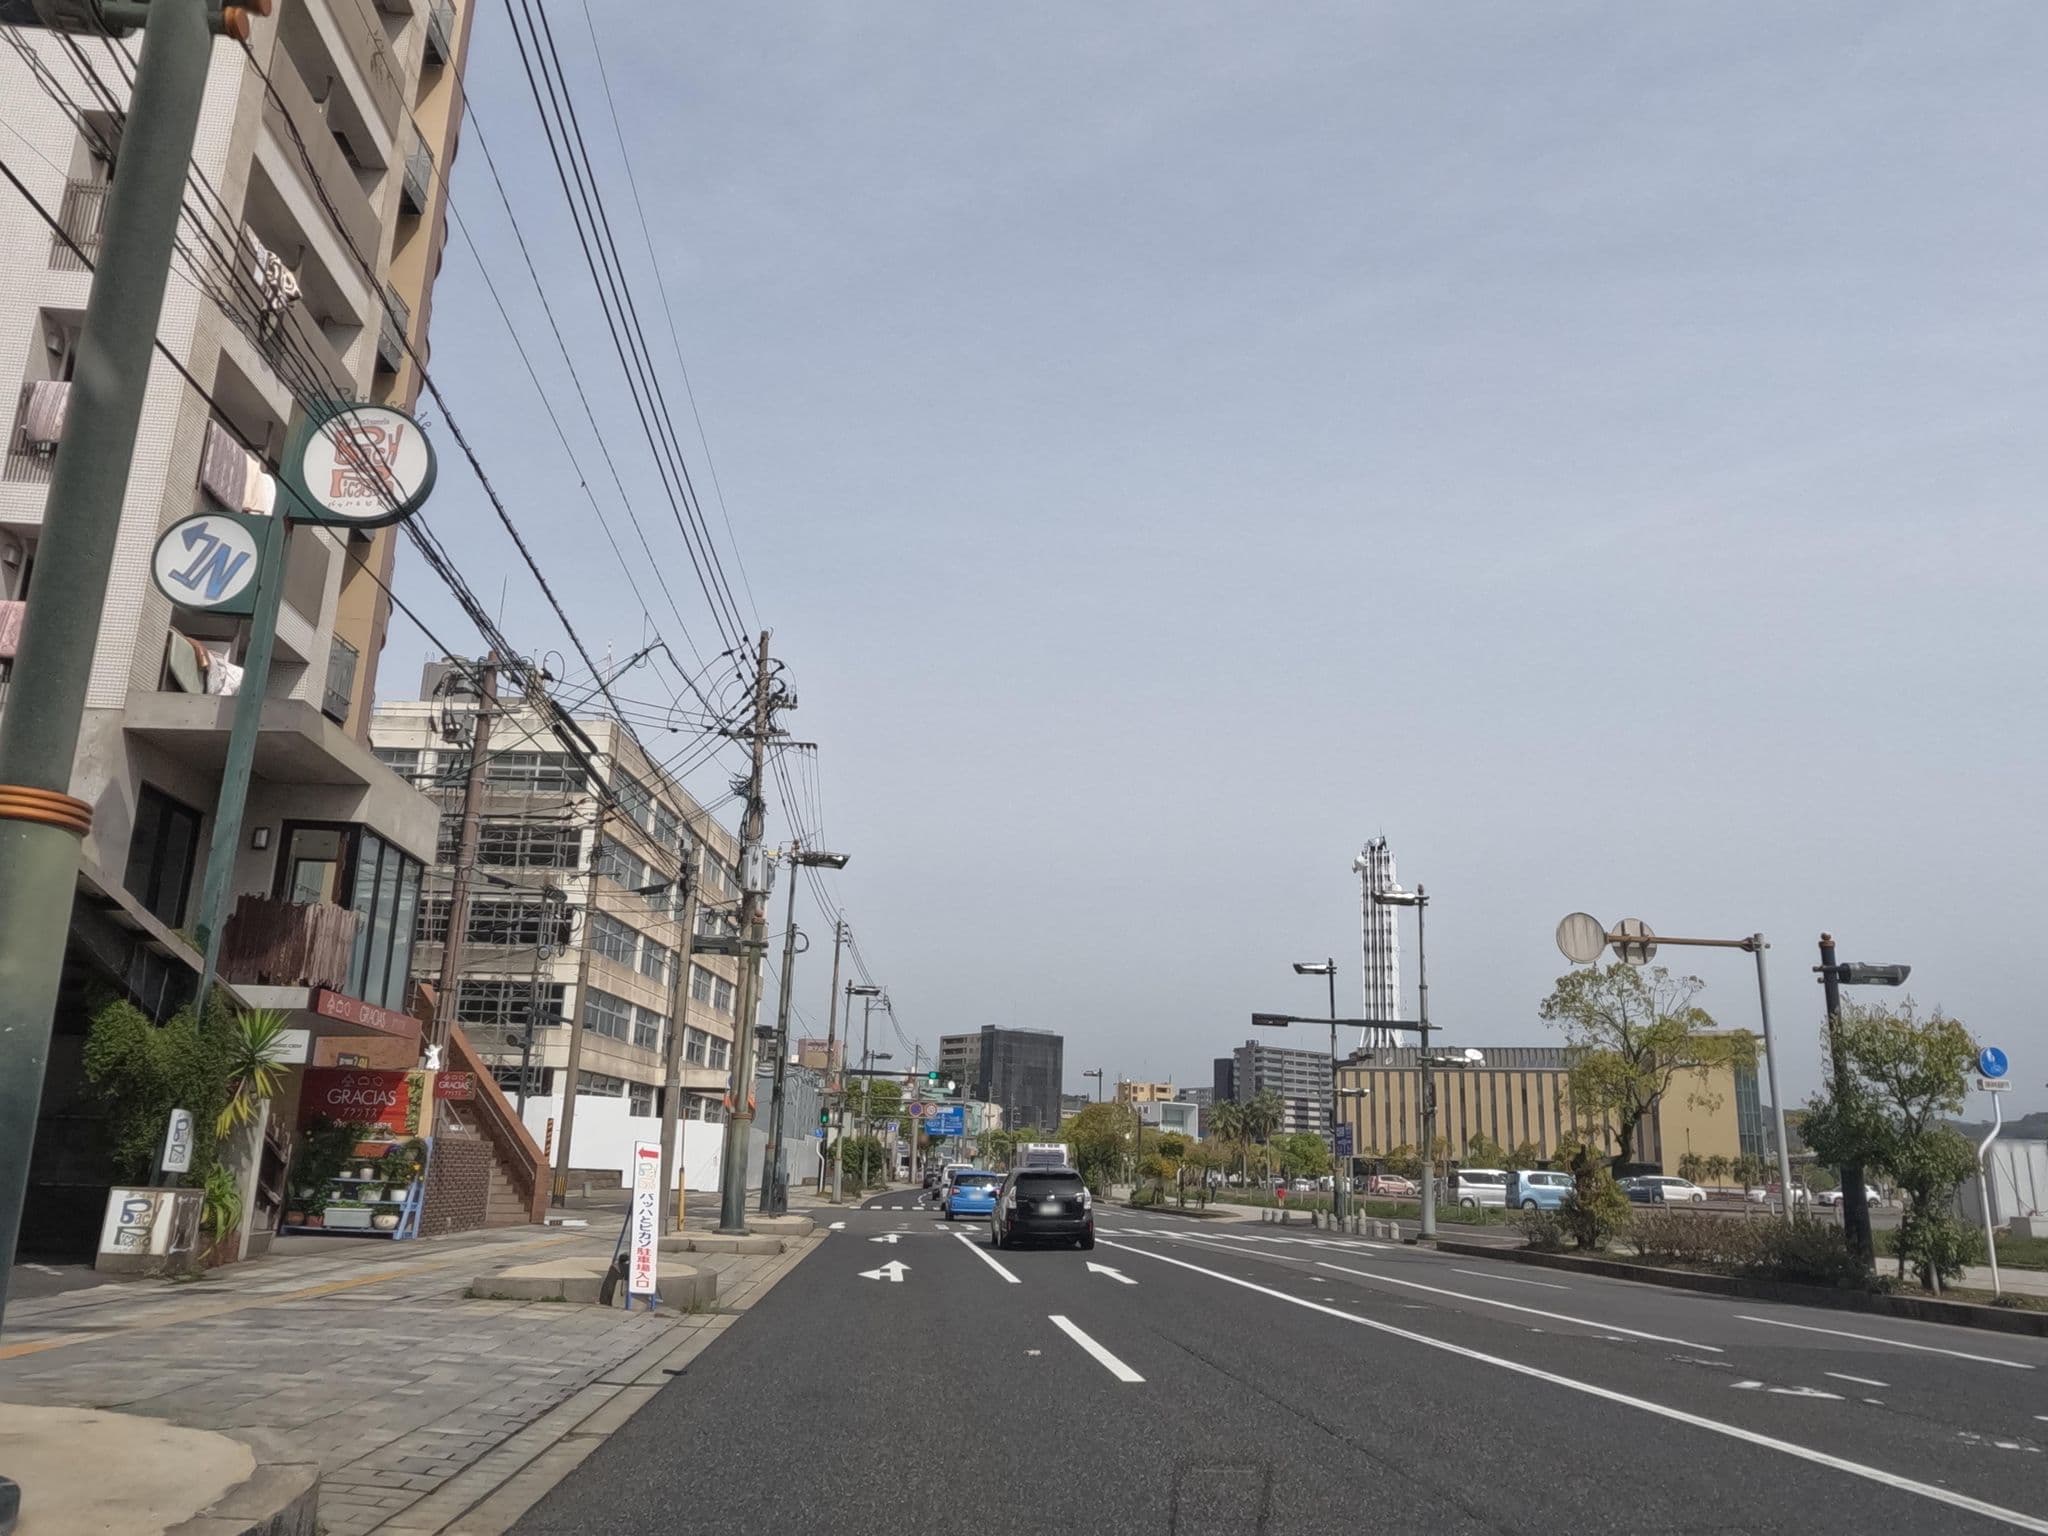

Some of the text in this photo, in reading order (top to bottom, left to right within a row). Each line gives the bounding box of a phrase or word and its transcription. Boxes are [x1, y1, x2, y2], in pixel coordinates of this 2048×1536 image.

[169, 536, 250, 600] IN
[359, 1005, 386, 1027] GRACIAS
[438, 1081, 470, 1089] GRACIAS
[327, 1088, 397, 1106] GRACIAS
